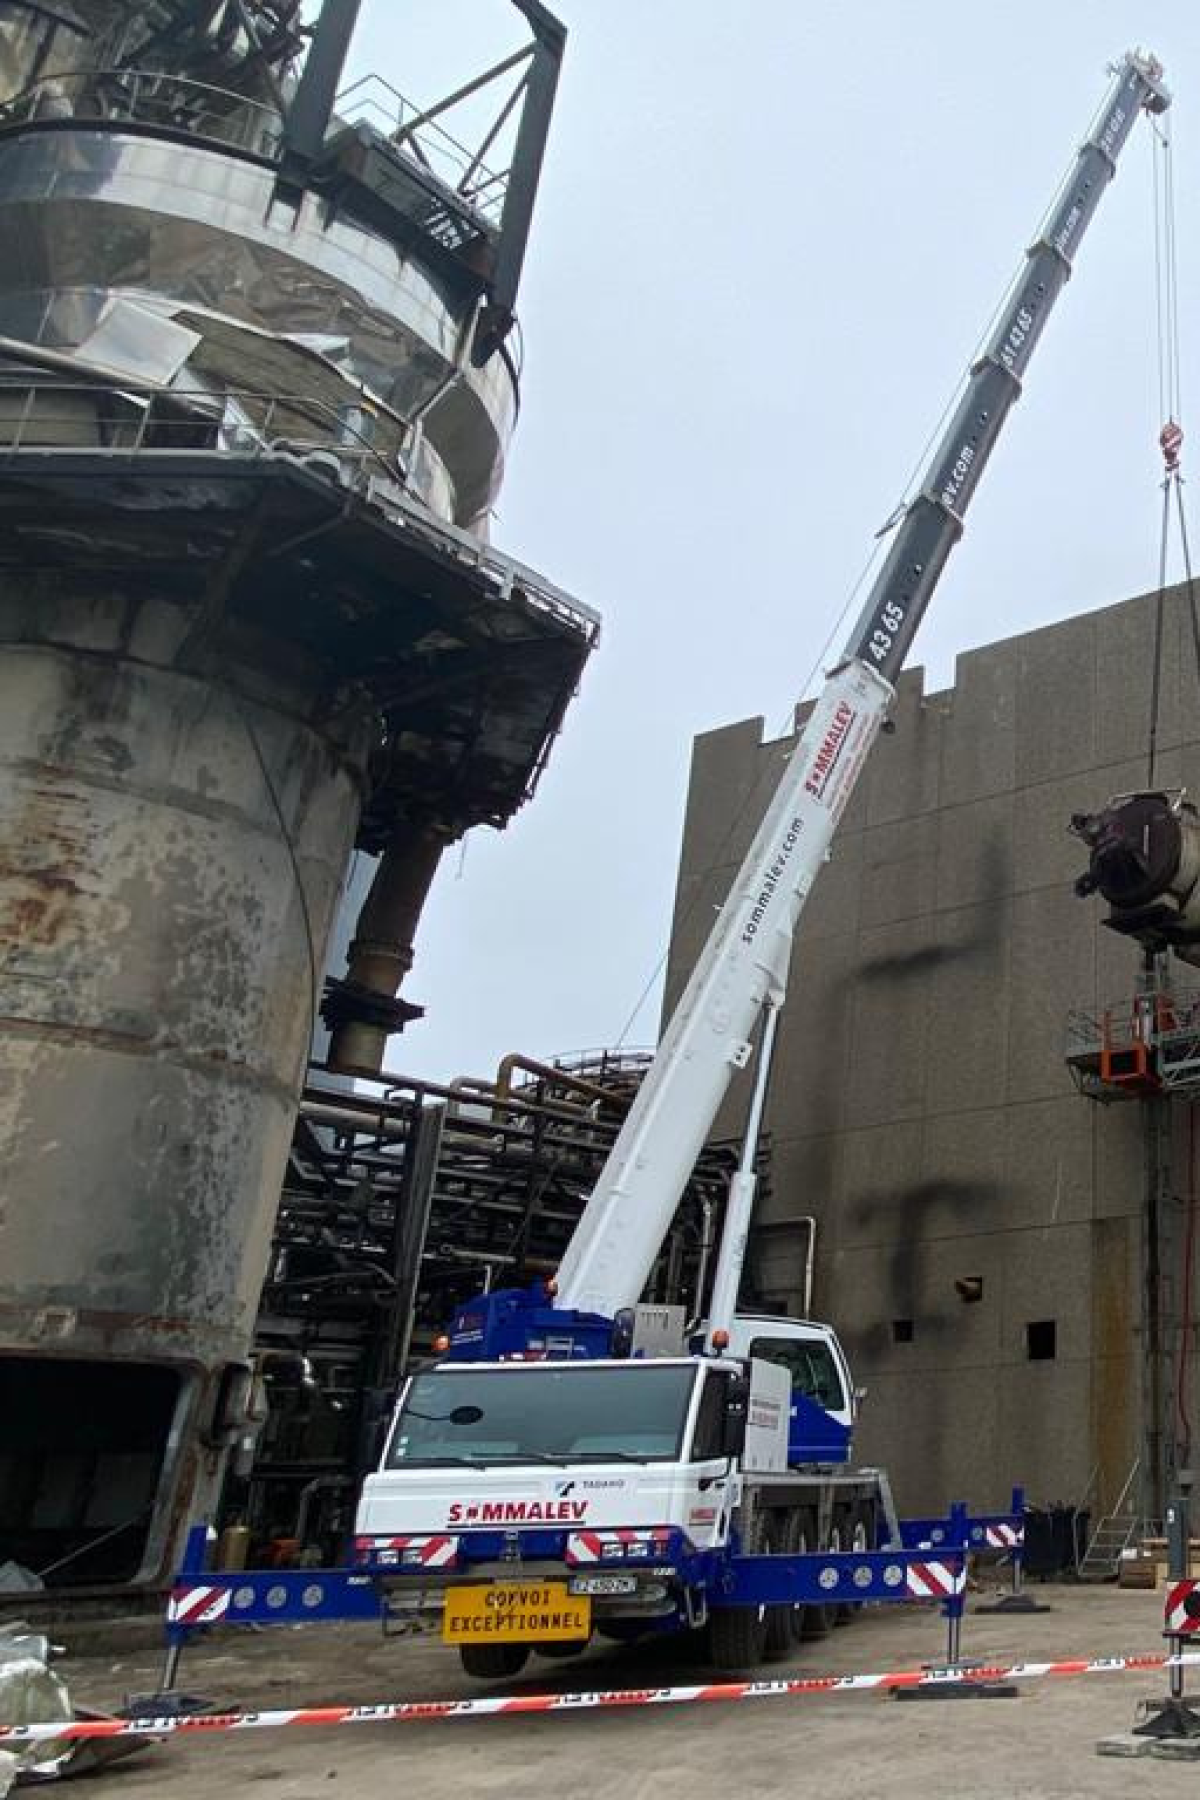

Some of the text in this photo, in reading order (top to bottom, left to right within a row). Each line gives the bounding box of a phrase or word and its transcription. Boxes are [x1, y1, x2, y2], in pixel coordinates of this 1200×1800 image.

[868, 601, 904, 661] 43 65
[742, 817, 803, 944] sommalev.com
[450, 1611, 583, 1632] EXCEPTIONNEL
